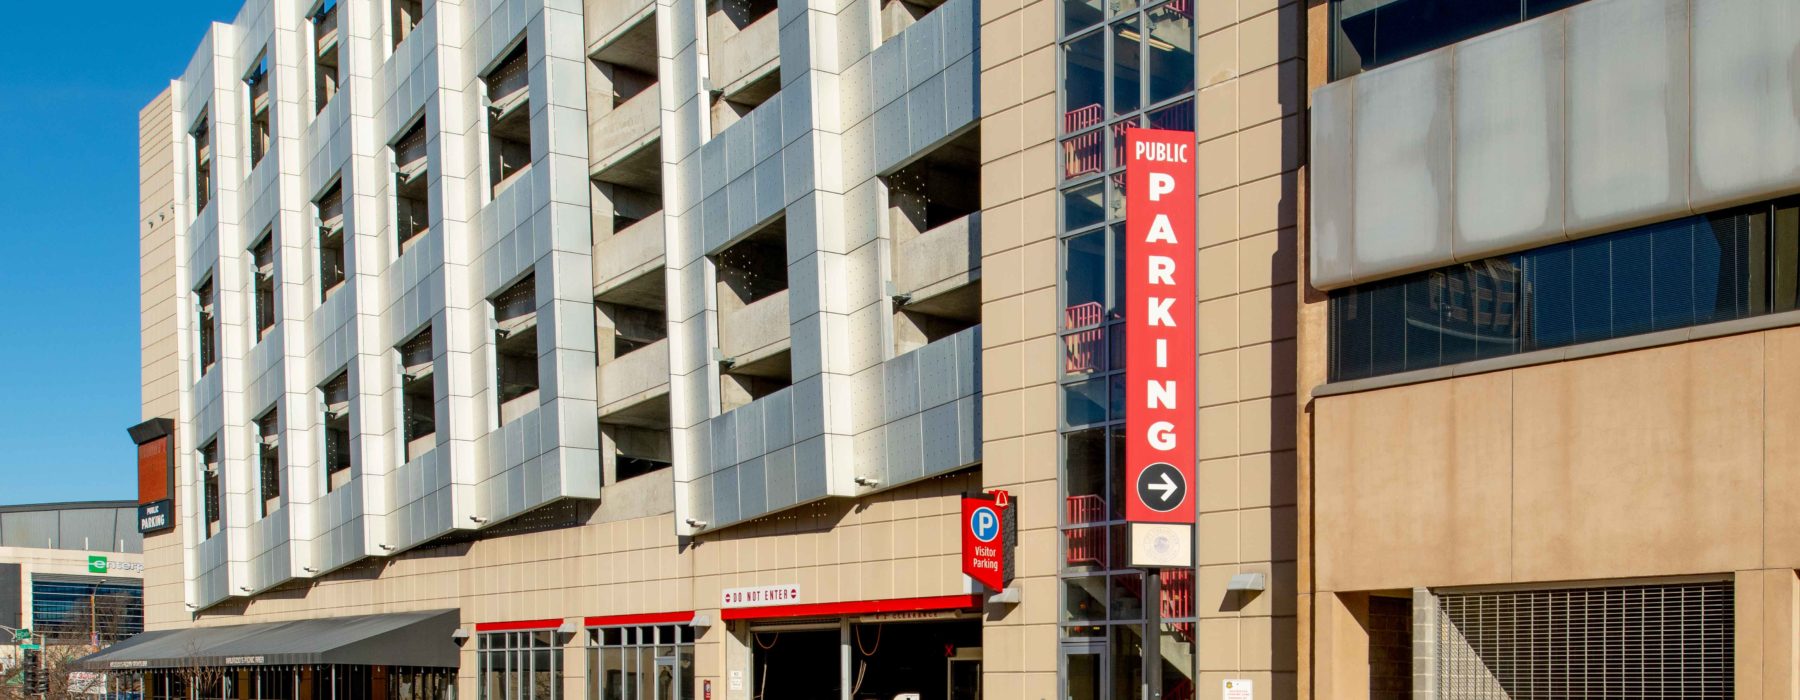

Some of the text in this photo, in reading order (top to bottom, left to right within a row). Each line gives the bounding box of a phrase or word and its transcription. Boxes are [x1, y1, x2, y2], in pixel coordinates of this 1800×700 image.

[1135, 141, 1188, 163] PUBLIC
[1145, 172, 1178, 452] PARKING
[147, 506, 159, 515] PUBLIC
[142, 514, 164, 529] PARKING
[979, 512, 993, 536] P
[975, 546, 996, 557] Visitor
[973, 558, 998, 571] Parking
[733, 589, 788, 602] DO NOT ENTER
